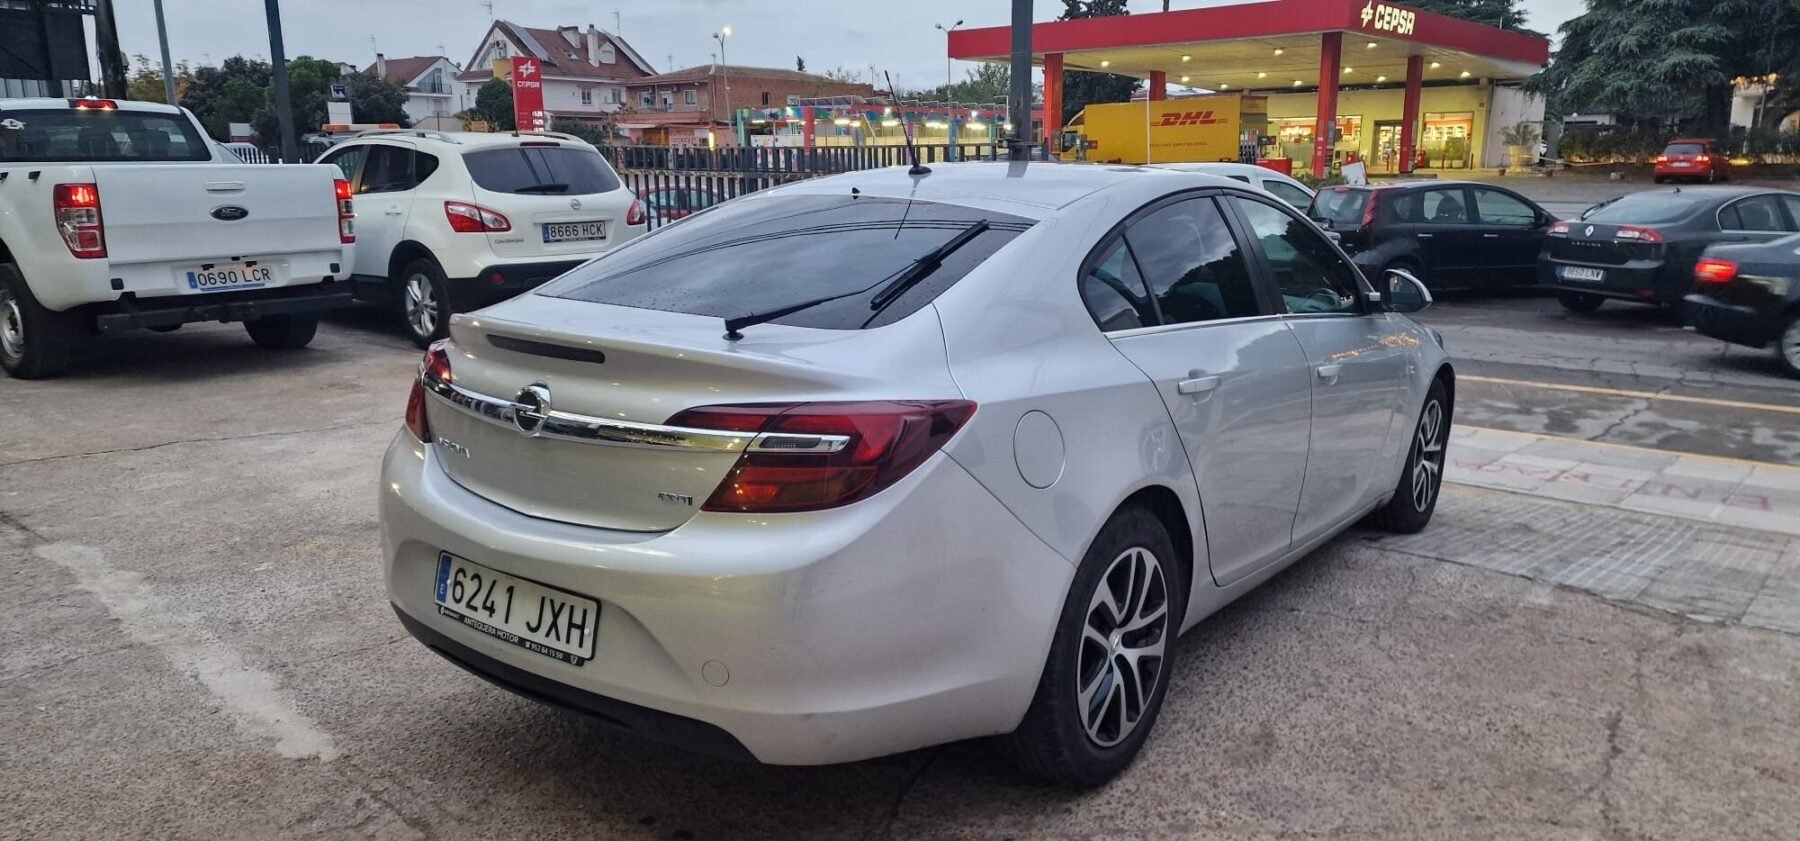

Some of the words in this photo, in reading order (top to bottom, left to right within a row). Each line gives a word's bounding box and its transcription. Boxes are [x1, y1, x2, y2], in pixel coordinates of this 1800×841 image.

[1374, 4, 1416, 36] CEPSA
[516, 80, 541, 89] CEPSA
[1160, 110, 1217, 127] DHL
[550, 225, 579, 238] 8666
[582, 223, 604, 236] HCK
[197, 271, 238, 286] 0690
[241, 268, 272, 283] LCR
[452, 567, 515, 624] 6241
[525, 596, 588, 649] JXH
[463, 616, 497, 637] ANTEQUERA
[497, 628, 520, 645] MOTOR
